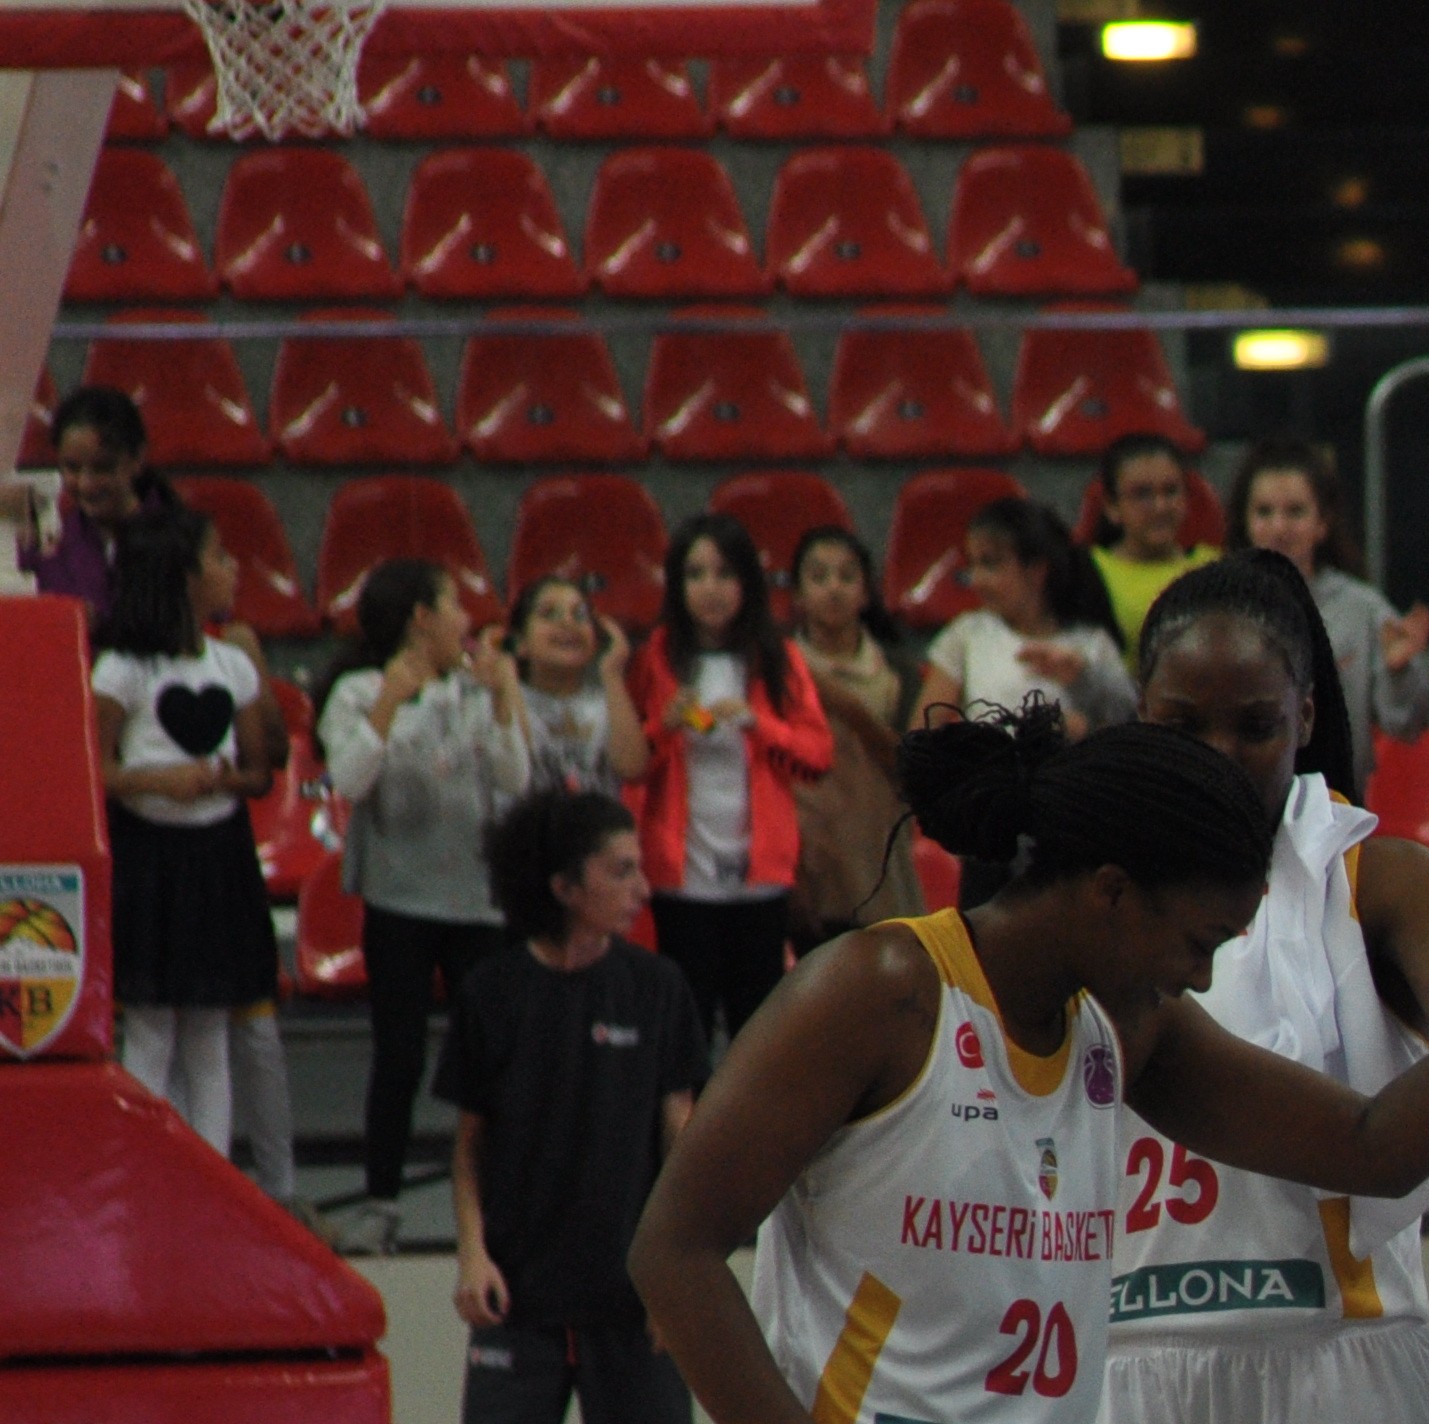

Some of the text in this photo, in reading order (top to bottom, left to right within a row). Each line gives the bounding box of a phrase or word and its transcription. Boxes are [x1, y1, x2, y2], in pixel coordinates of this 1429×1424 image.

[951, 1102, 999, 1121] upa
[1126, 1137, 1219, 1234] 25
[985, 1298, 1078, 1398] 20
